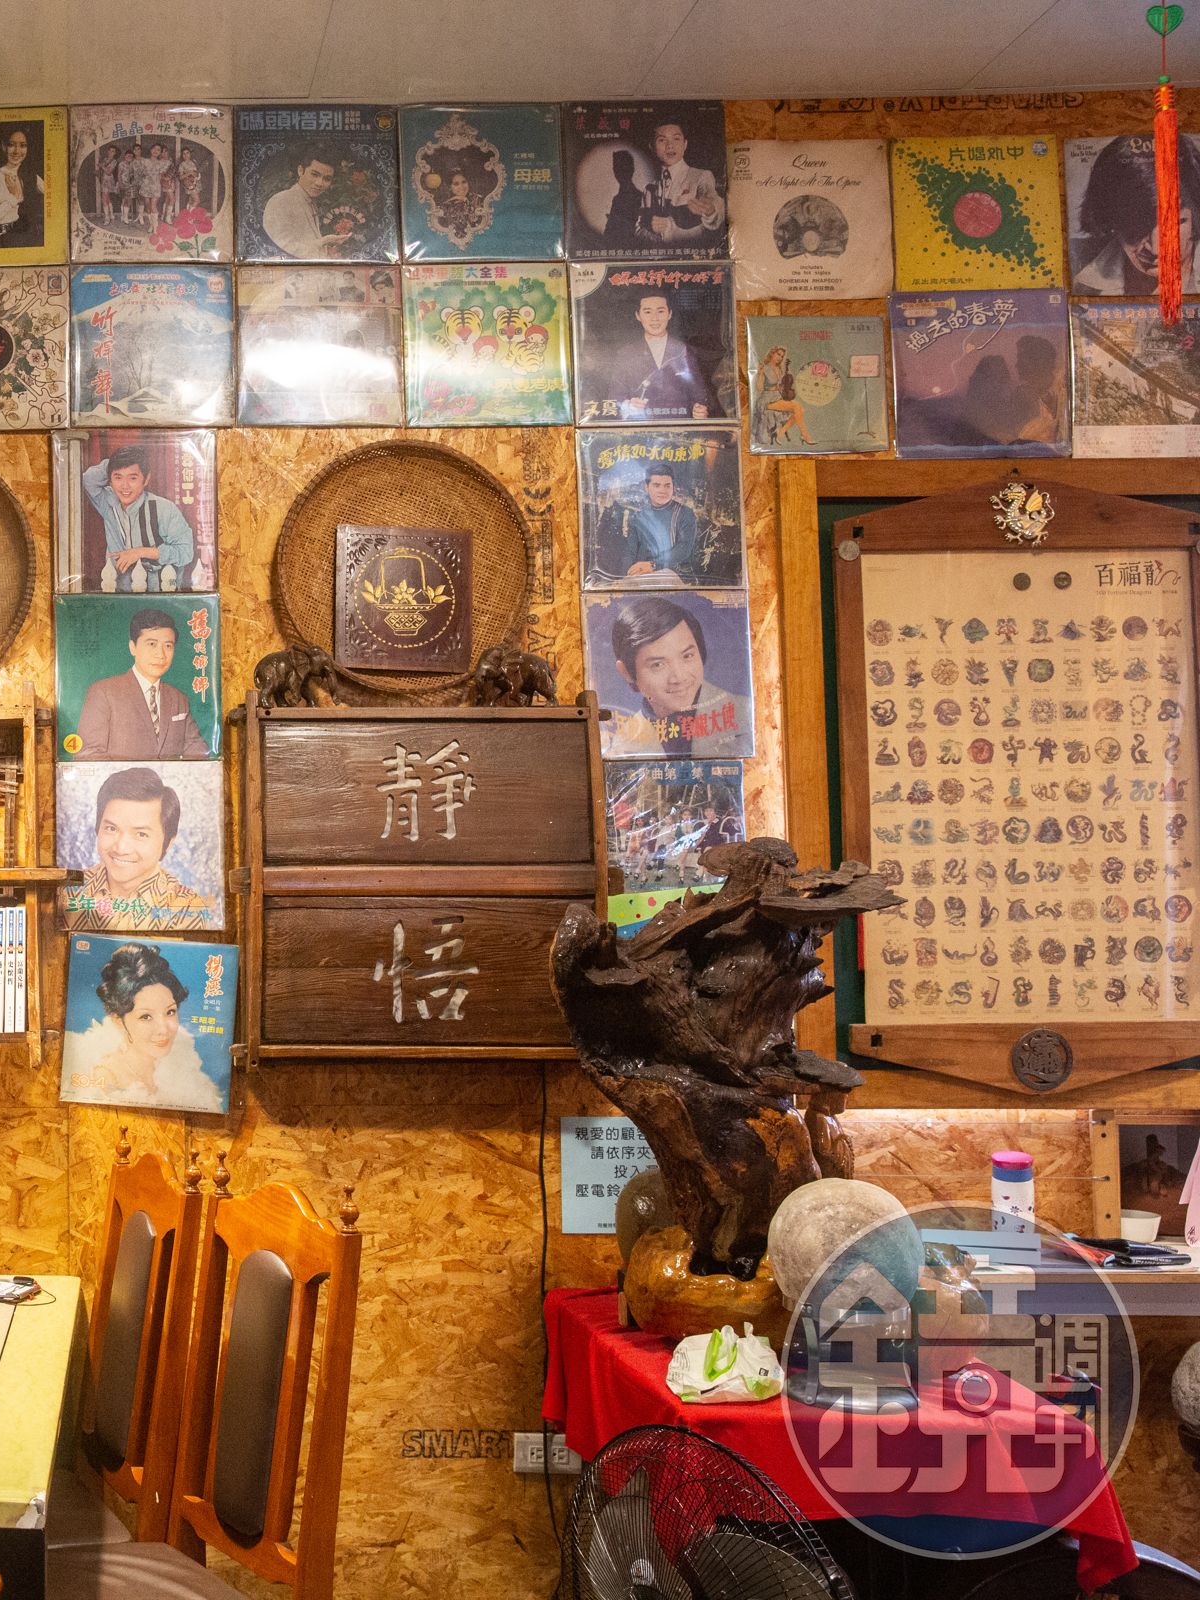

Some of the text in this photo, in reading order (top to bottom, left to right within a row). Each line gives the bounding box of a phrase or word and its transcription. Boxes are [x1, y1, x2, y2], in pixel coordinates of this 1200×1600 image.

[239, 110, 342, 131] 碼頭惜別
[792, 154, 829, 171] Queen
[775, 175, 801, 188] Night
[820, 175, 839, 187] The
[838, 176, 862, 189] Opera
[905, 299, 1019, 353] 過去的春夢
[598, 442, 705, 469] 愛情如水向東流
[65, 736, 78, 751] 4
[374, 739, 477, 843] 靜
[65, 894, 149, 921] 三年後的我
[203, 954, 225, 998] 楊燕
[373, 915, 480, 1024] 悟
[590, 1146, 658, 1161] 請依序夾
[575, 1183, 627, 1199] 壓電鈴
